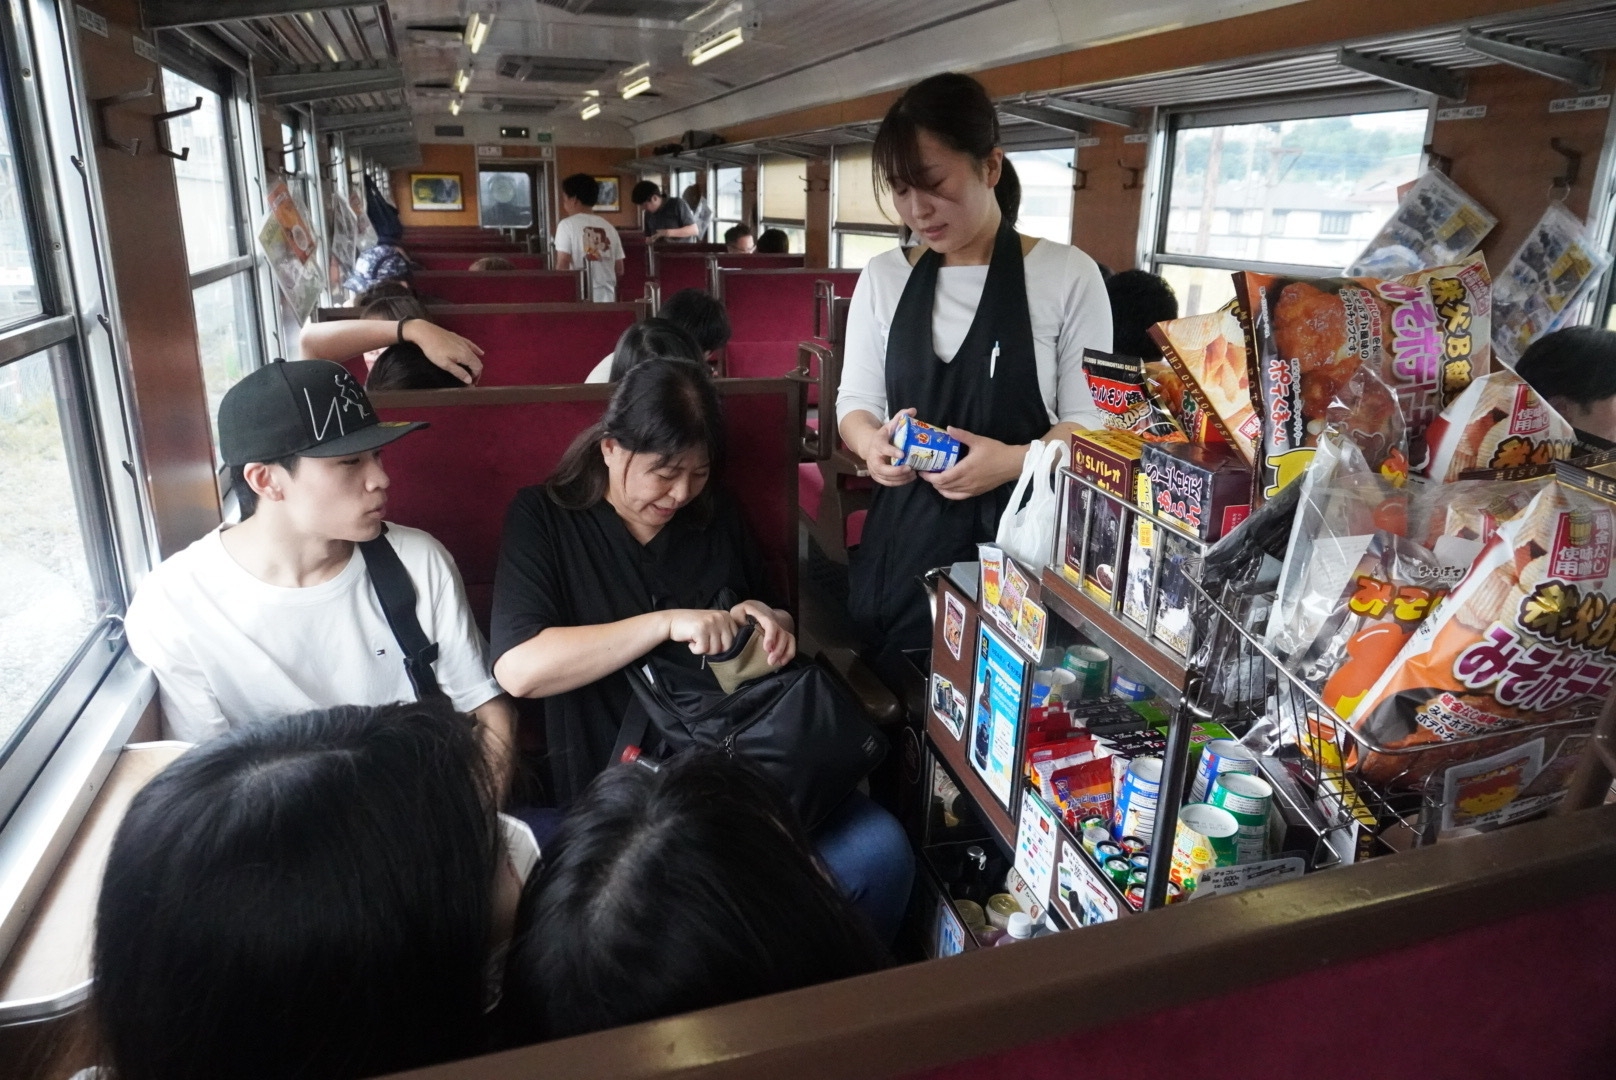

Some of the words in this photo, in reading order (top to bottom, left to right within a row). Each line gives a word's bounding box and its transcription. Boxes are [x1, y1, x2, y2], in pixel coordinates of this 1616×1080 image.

[1267, 359, 1293, 446] ポテくまくん
[1085, 454, 1121, 484] SLパレオ
[1496, 468, 1538, 481] MISO
[1555, 546, 1580, 576] 使用
